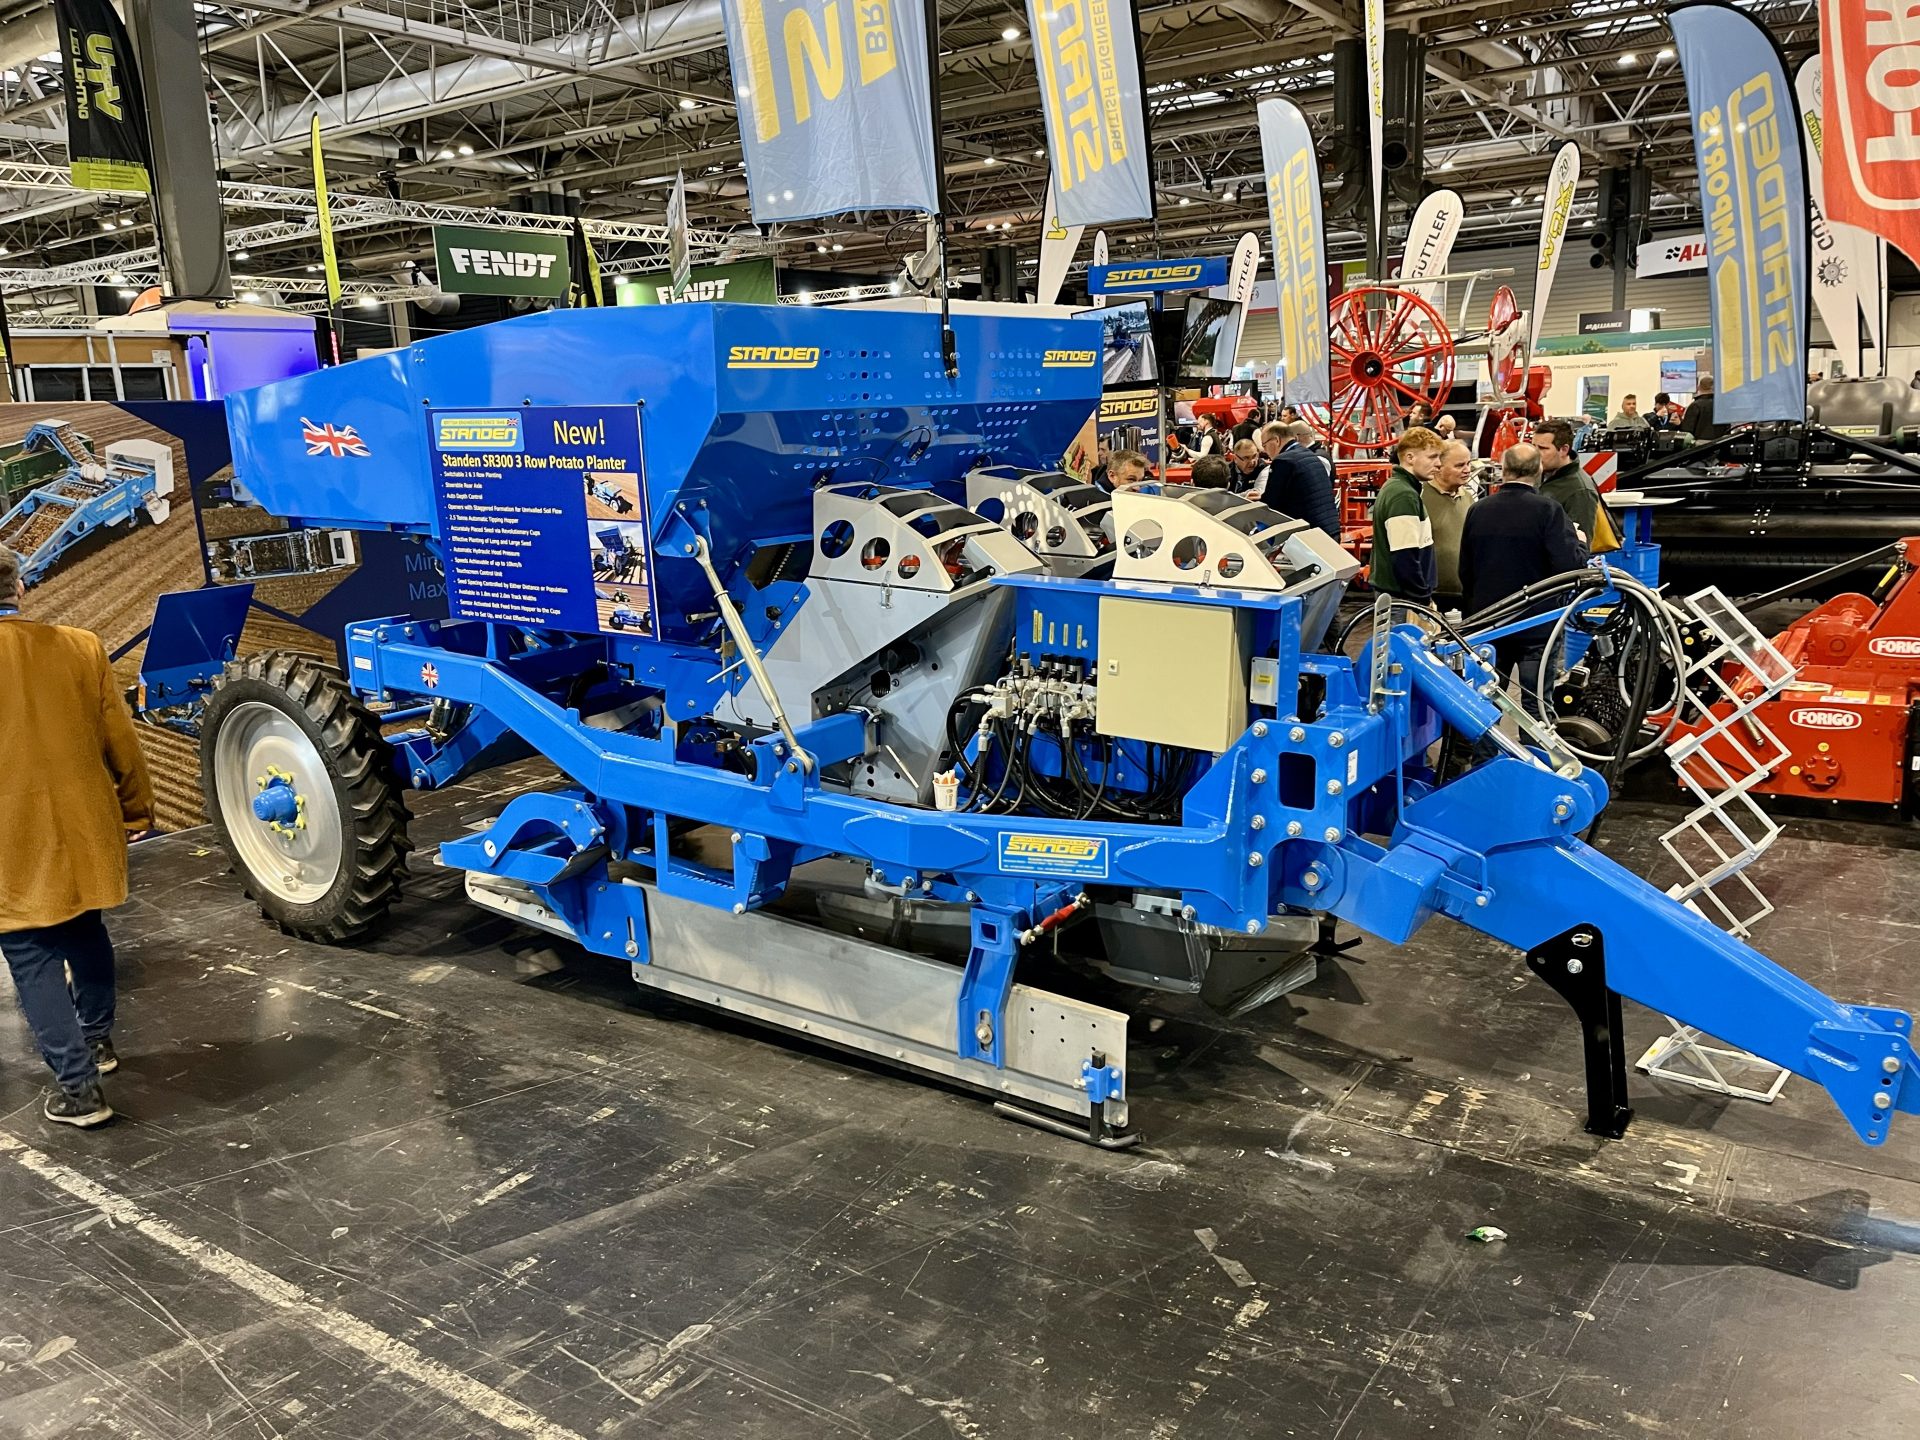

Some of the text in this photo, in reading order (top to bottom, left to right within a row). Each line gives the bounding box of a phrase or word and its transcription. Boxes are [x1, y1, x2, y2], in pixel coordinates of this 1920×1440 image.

[68, 28, 90, 120] LED LIGHTING
[1411, 209, 1449, 279] GÜTTLER
[449, 247, 557, 278] FENDT
[1105, 265, 1202, 282] STANDEN
[1591, 321, 1623, 332] ALLIANCE
[728, 346, 820, 362] STANDEN
[1043, 350, 1097, 362] STANDEN
[1100, 398, 1159, 415] STANDEN
[439, 428, 518, 441] STANDEN
[553, 418, 606, 446] New!
[442, 453, 627, 471] Standen SR300 3 Row Potato Planter
[408, 581, 447, 600] Max
[1797, 711, 1855, 727] FORIGO
[1006, 841, 1099, 857] STANDEN
